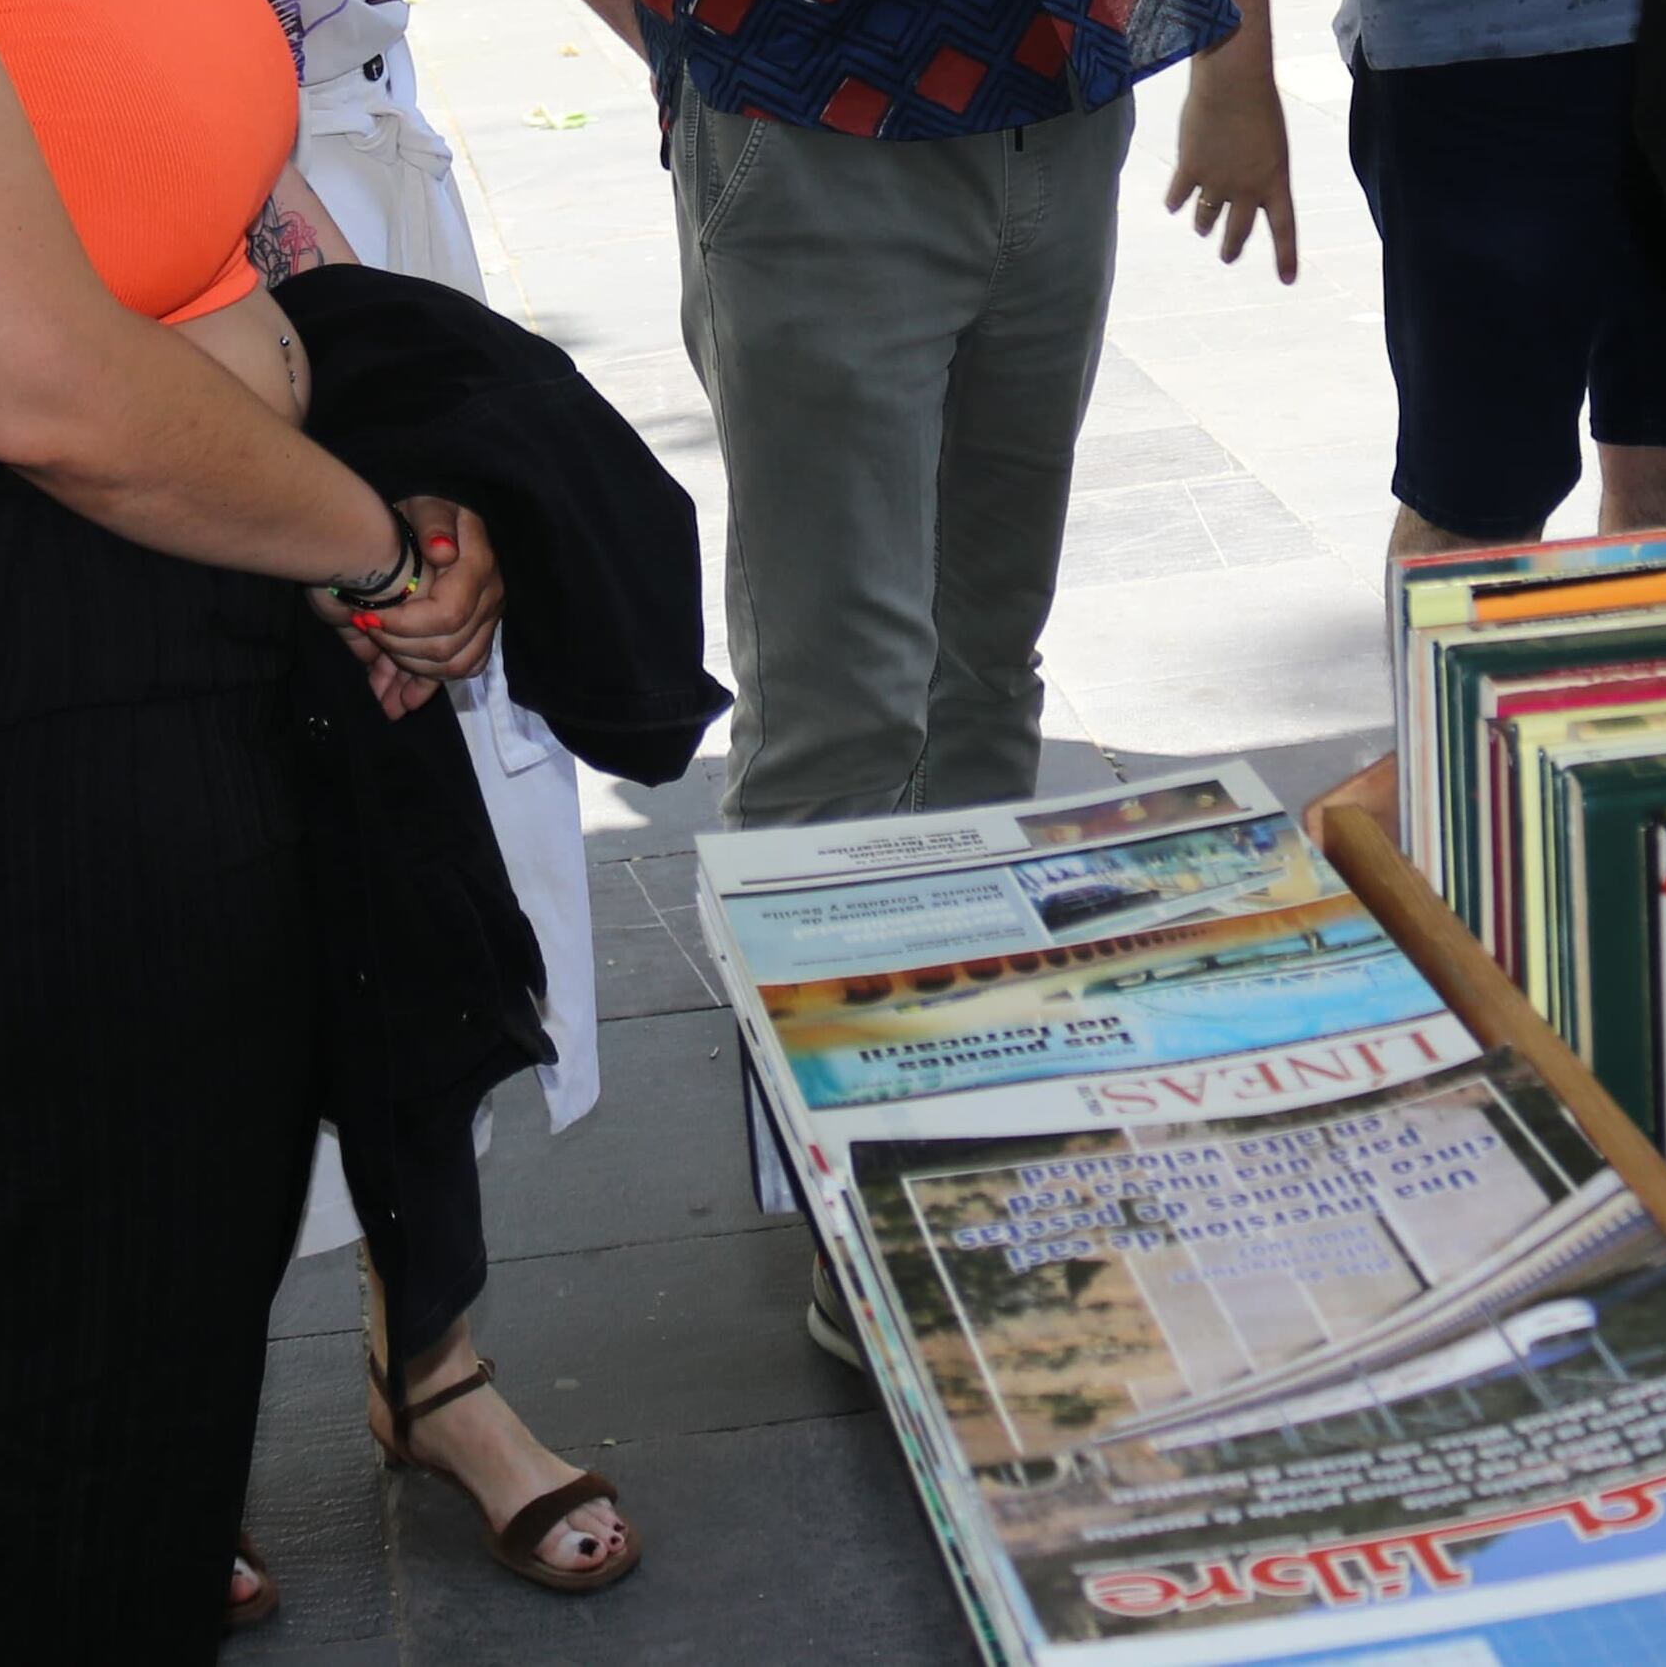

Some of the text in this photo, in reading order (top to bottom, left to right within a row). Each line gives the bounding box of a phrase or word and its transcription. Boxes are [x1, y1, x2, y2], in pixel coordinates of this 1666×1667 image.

[856, 1015, 1124, 1065] del ferrocarril
[895, 1036, 1047, 1075] puentes
[1060, 1029, 1135, 1054] Los
[1098, 1031, 1444, 1117] LÍNEAS
[1005, 1124, 1422, 1219] para una nueva red
[1016, 1114, 1383, 1190] en alta velocidad
[951, 1133, 1497, 1252] cinco billones de pesetas
[1392, 1167, 1479, 1205] Una
[1005, 1239, 1090, 1274] casi
[1108, 1227, 1160, 1254] de
[1082, 1528, 1471, 1618] libre
